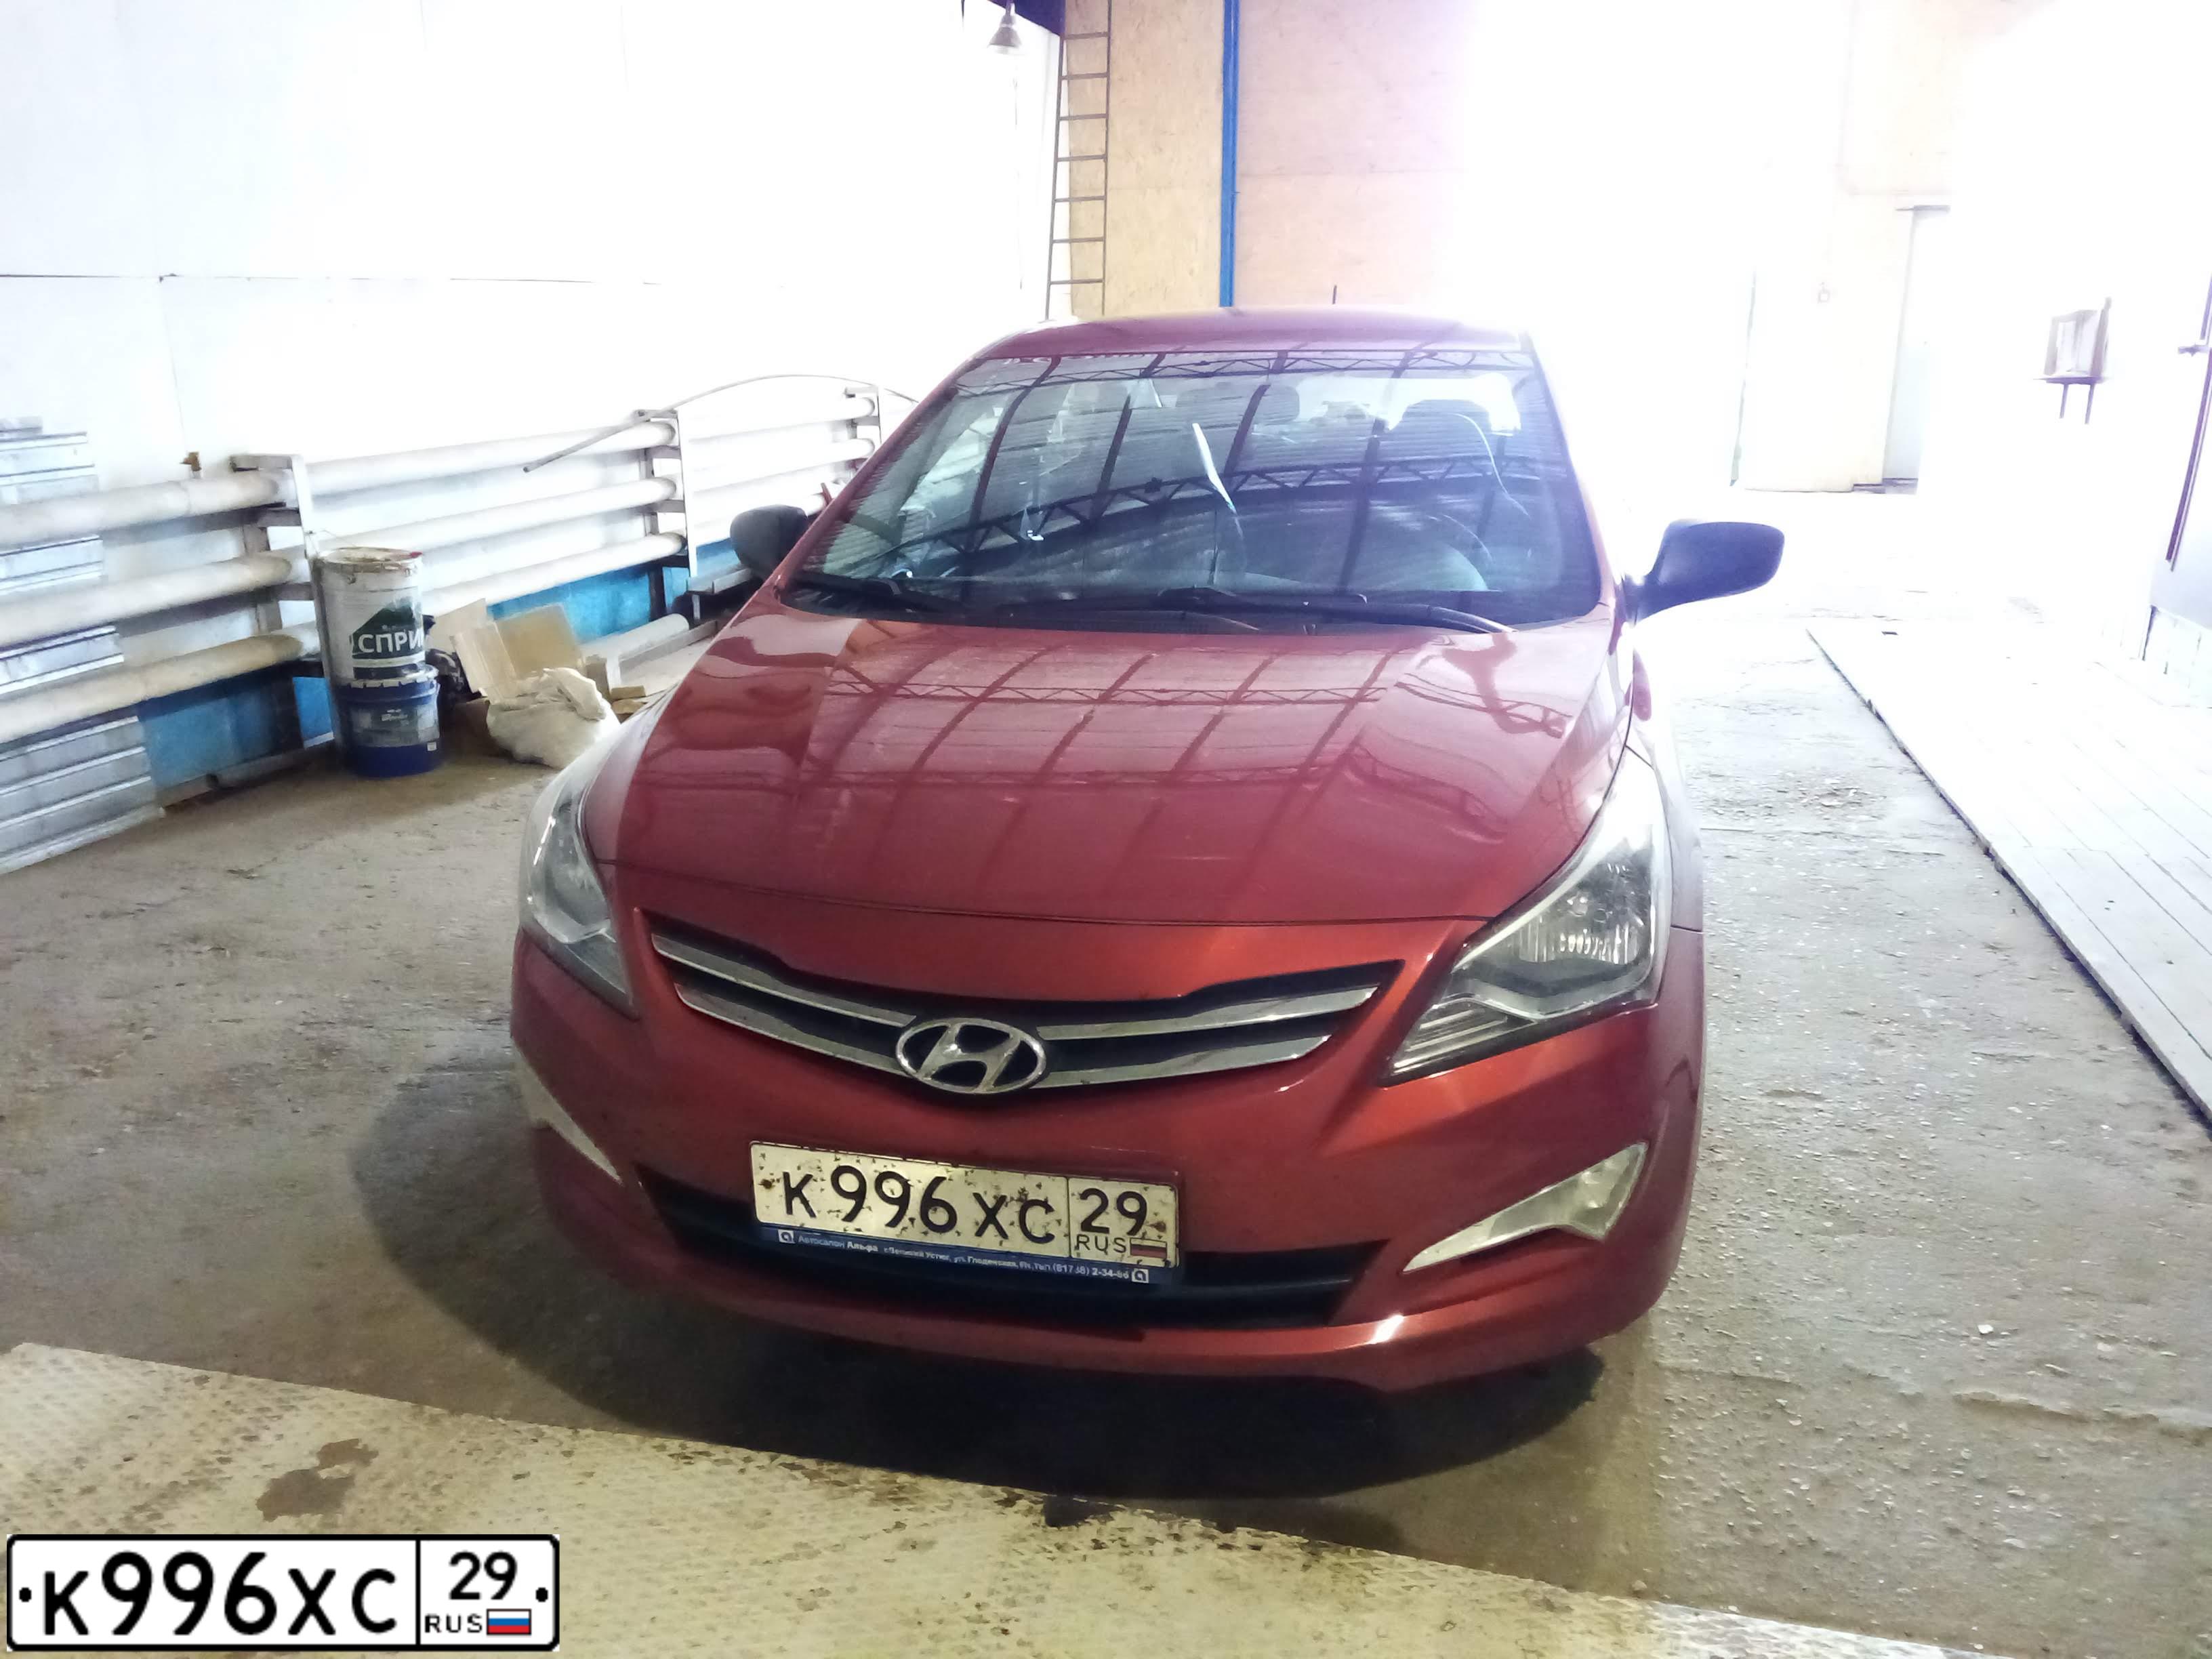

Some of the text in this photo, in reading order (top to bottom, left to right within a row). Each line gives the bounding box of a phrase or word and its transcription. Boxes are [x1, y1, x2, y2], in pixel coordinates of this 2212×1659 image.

[1080, 1187, 1147, 1236] 29
[847, 1242, 879, 1252] Альфа
[1076, 1234, 1127, 1254] RUS
